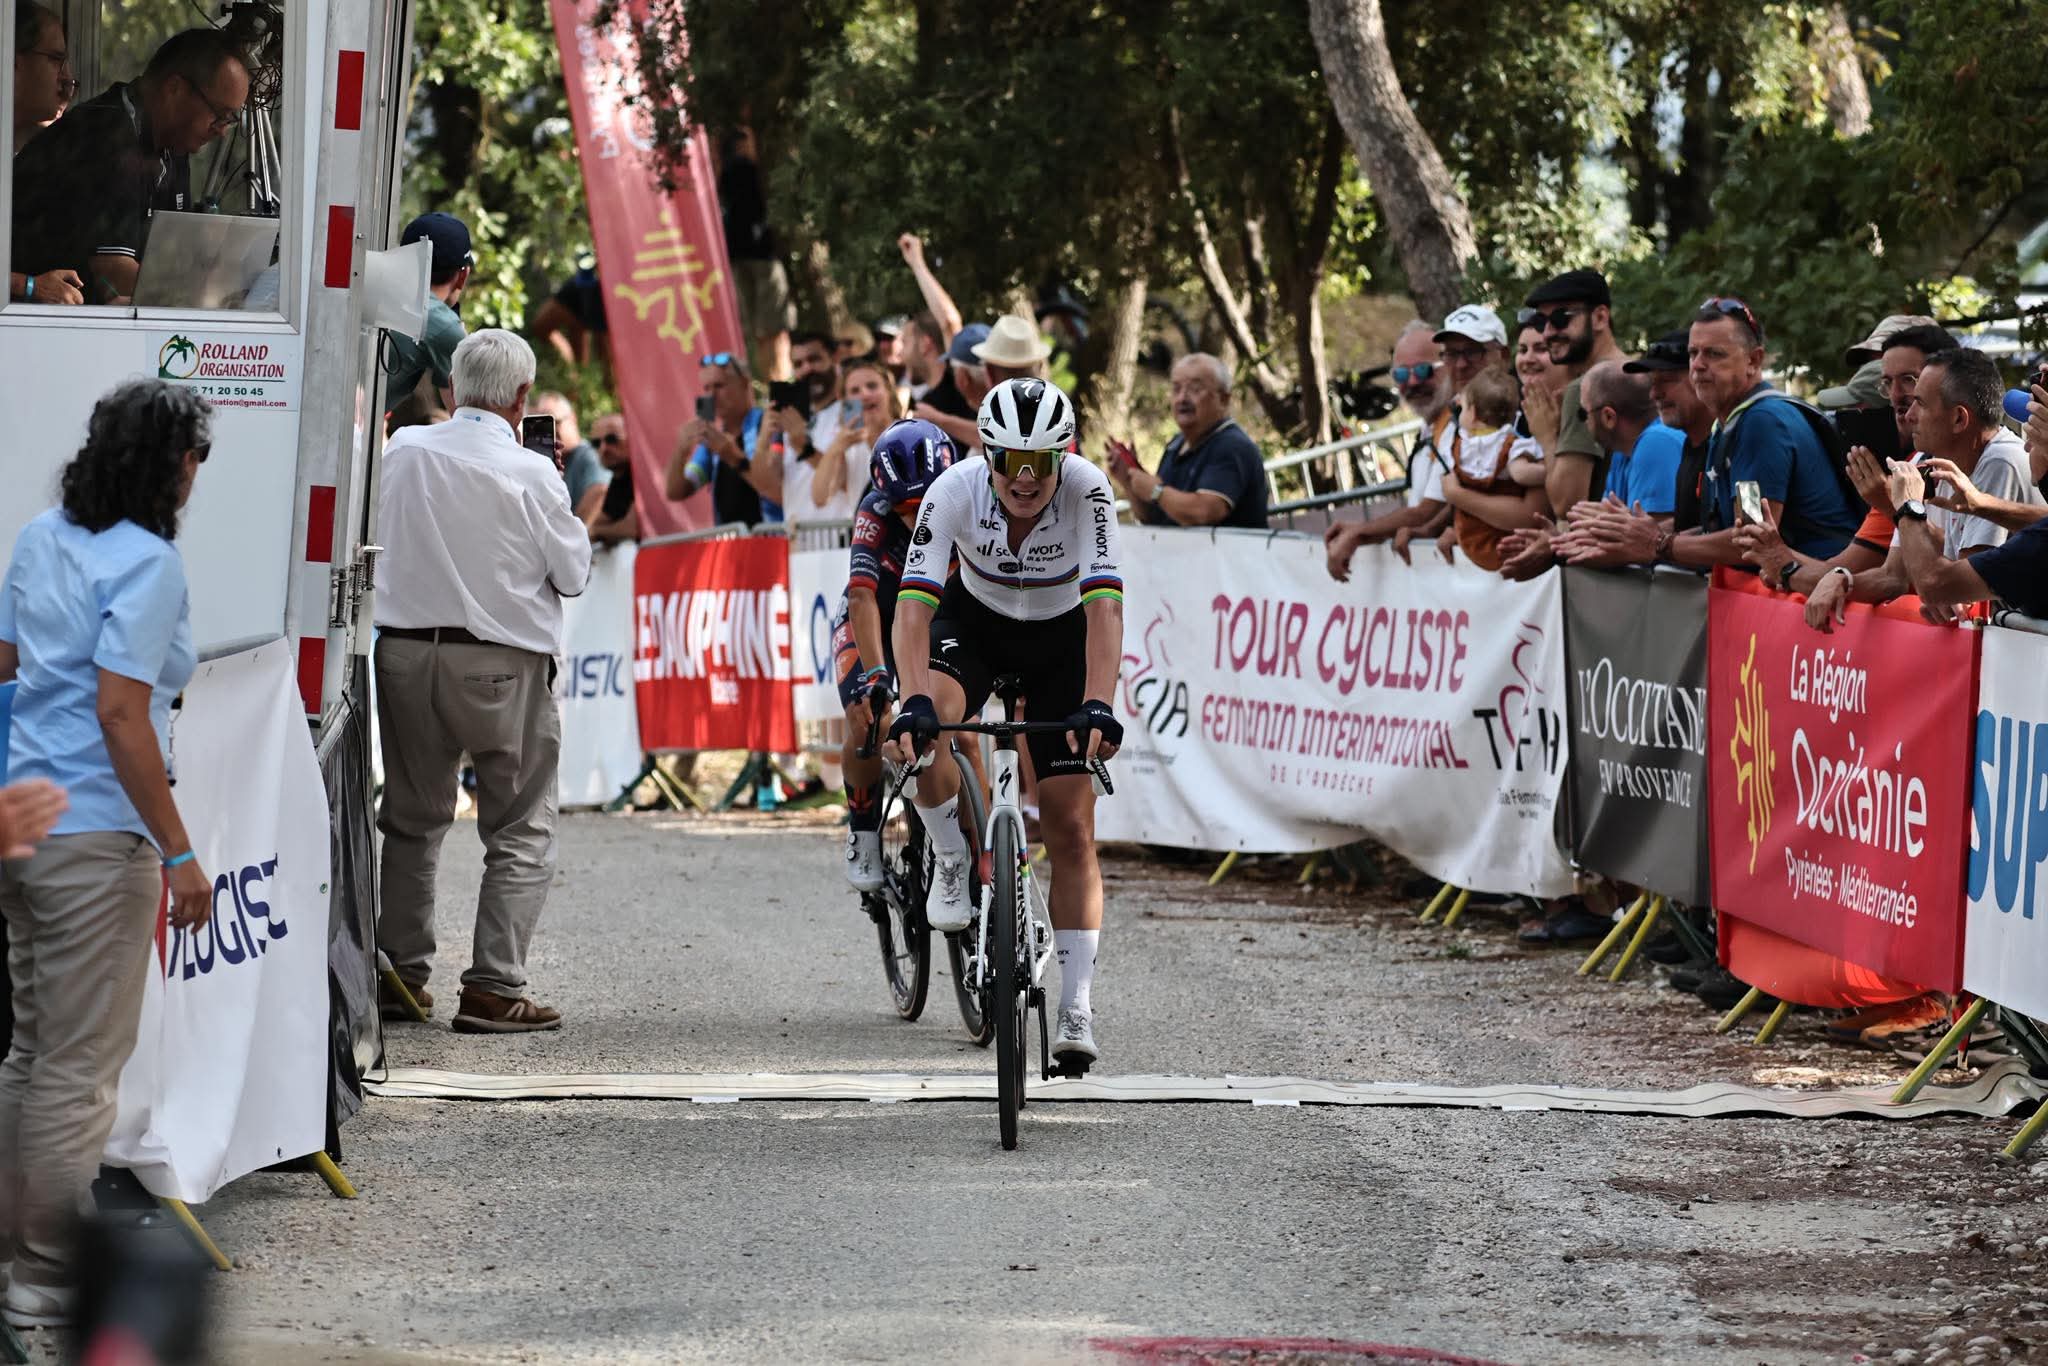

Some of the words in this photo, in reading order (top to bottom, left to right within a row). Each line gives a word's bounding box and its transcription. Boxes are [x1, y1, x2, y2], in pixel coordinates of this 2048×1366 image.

[200, 362, 284, 378] ORGANISATION
[201, 343, 268, 360] ROLLAND
[202, 386, 213, 395] 71
[218, 387, 231, 395] 20
[234, 387, 247, 395] 50
[250, 388, 264, 396] 45
[207, 398, 287, 408] isation@gmail.com
[1028, 541, 1064, 555] worx
[1096, 524, 1109, 558] worx
[1212, 594, 1308, 679] TOUR
[1317, 604, 1469, 695] CYCLISTE
[1790, 645, 1808, 702] La
[1811, 648, 1867, 723] Région
[1201, 694, 1296, 753] FEMININ
[1300, 706, 1469, 769] INTERNATIONAL
[1616, 762, 1692, 808] PROVENCE
[1791, 728, 1927, 858] Occitanie
[1785, 846, 1833, 900] Pyrénées
[1837, 863, 1917, 929] Méditerranée
